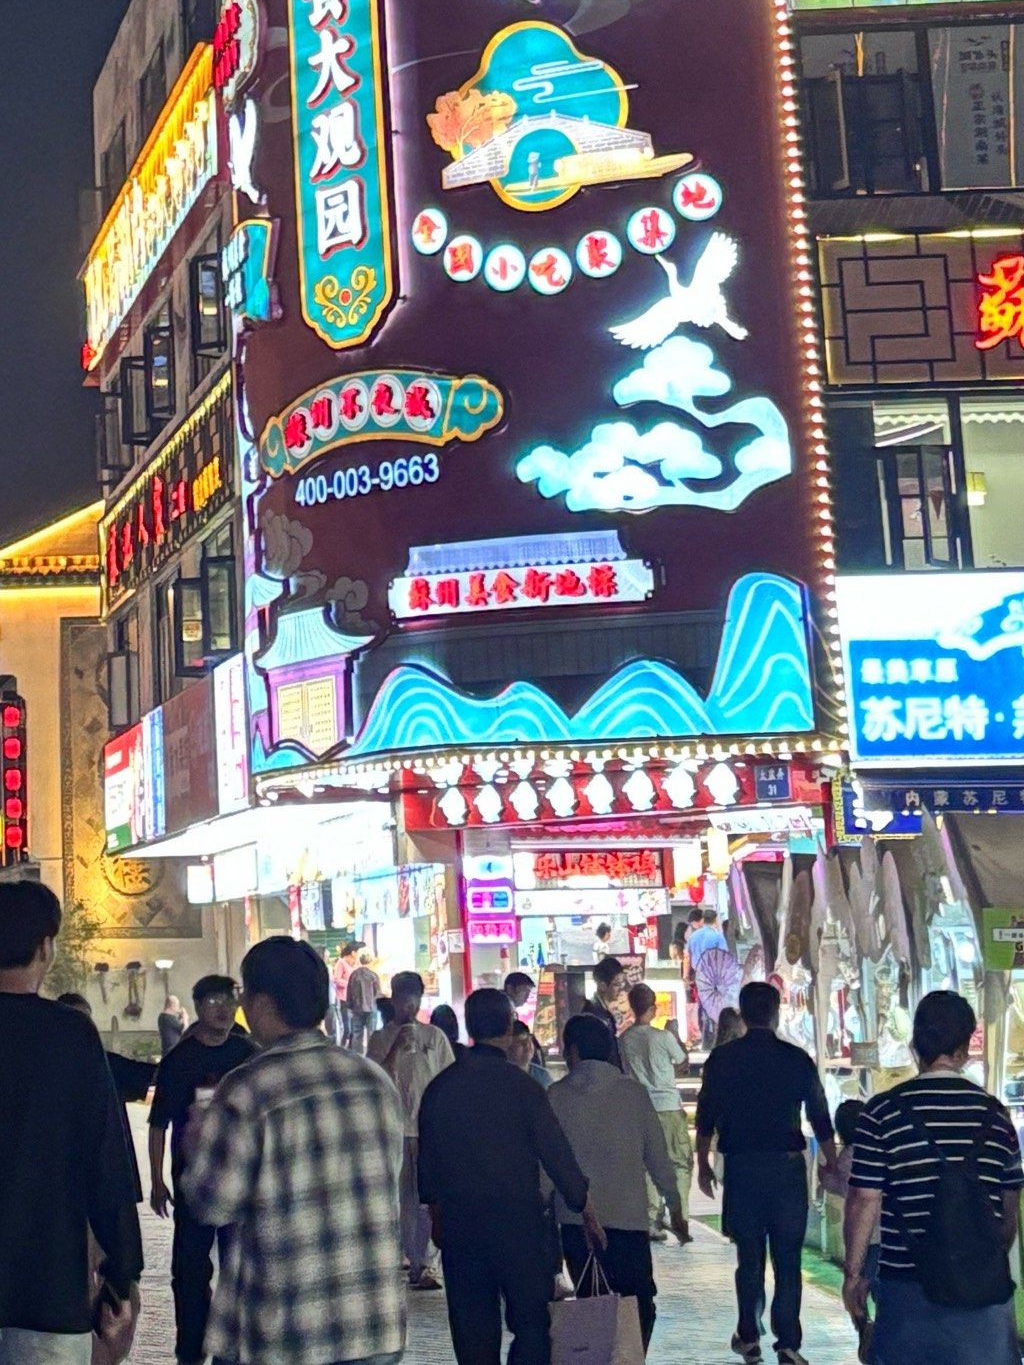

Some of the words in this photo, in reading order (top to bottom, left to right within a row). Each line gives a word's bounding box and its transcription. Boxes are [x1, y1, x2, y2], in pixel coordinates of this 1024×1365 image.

[294, 452, 440, 507] 400-003-9663
[532, 849, 657, 880] 乐山钵钵鸡
